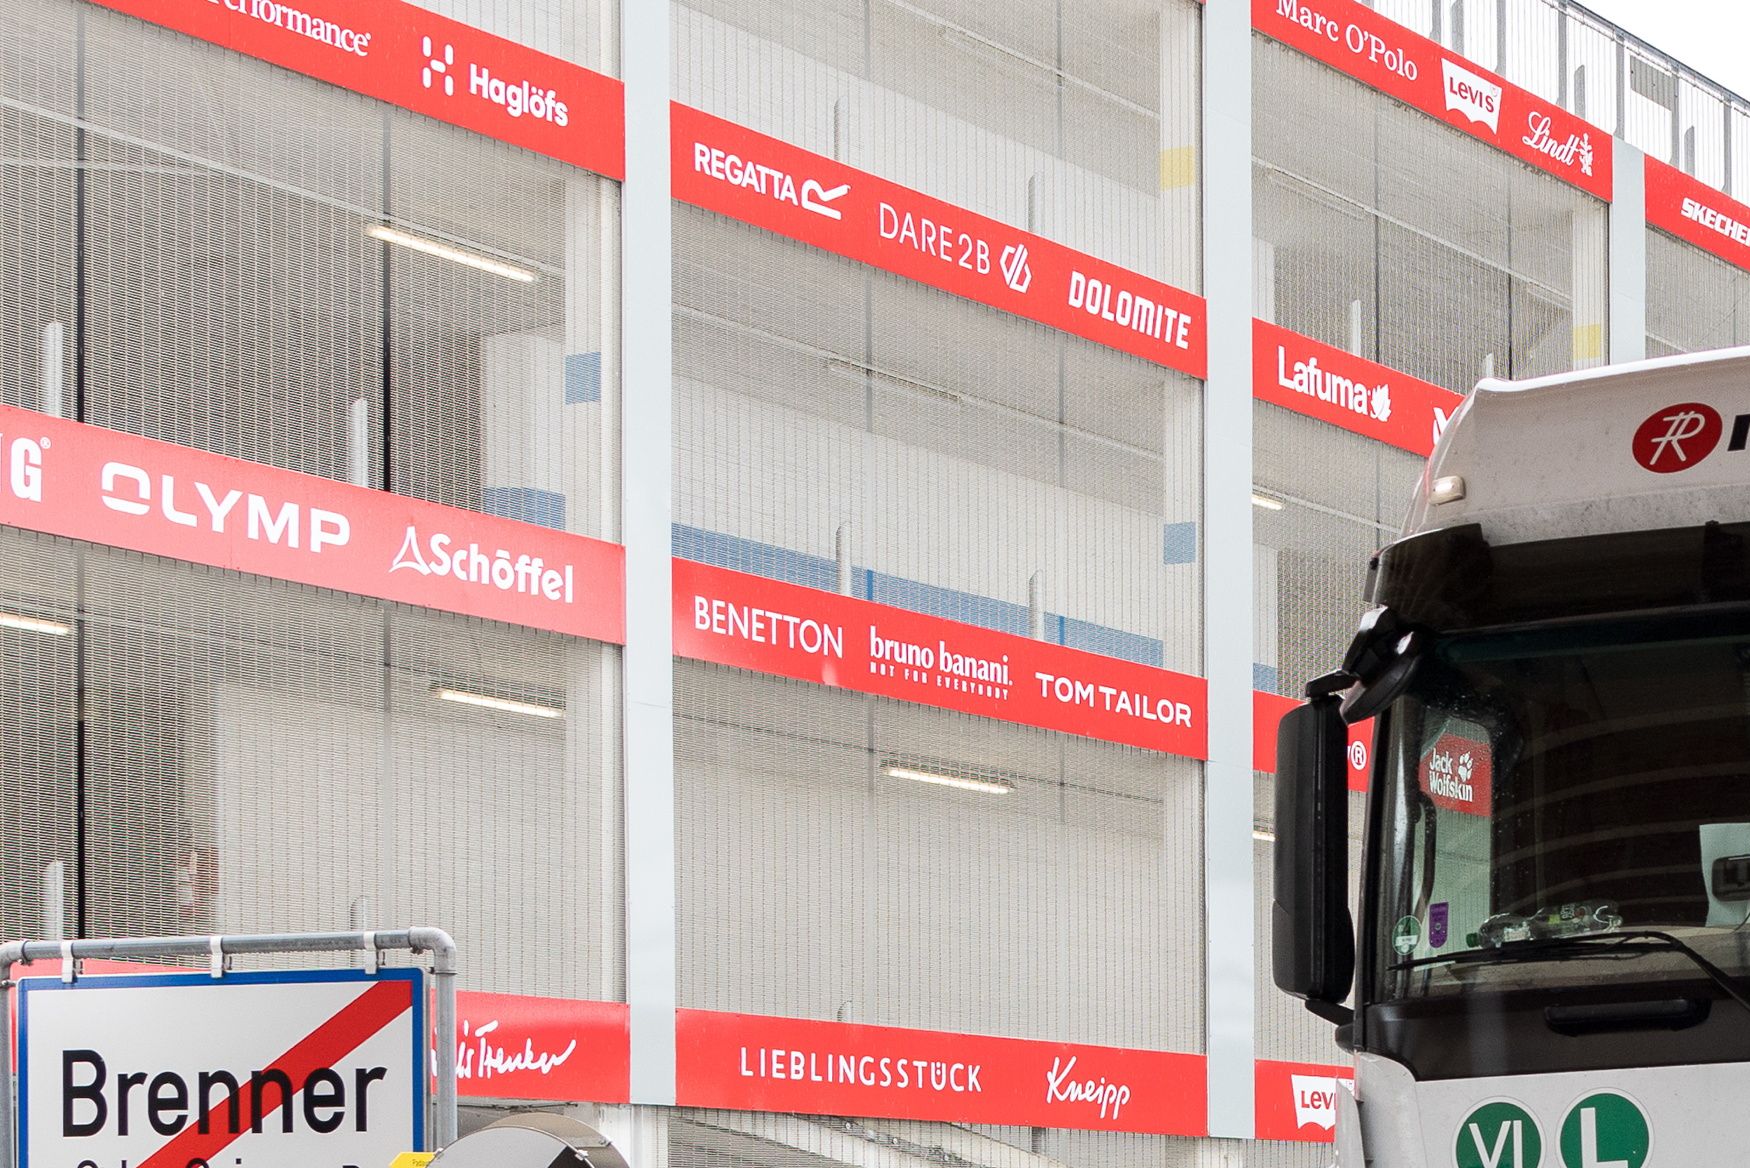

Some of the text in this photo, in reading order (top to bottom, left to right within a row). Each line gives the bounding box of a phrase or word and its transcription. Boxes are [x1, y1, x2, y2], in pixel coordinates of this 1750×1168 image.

[1276, 0, 1419, 81] Marc O'Polo
[469, 62, 569, 127] Haglöfs
[1522, 111, 1578, 166] Lindt
[694, 142, 799, 206] REGATTA
[1068, 270, 1191, 350] DOLOMITE
[1278, 345, 1370, 415] Lafuma
[101, 461, 351, 554] OLYMP
[429, 533, 574, 603] Schöffel
[694, 596, 843, 658] BENETTON
[870, 625, 935, 669] bruno
[1036, 672, 1192, 728] TOM TAILOR
[1429, 748, 1453, 774] Jack
[1429, 770, 1473, 802] Wolfskin
[63, 1049, 388, 1138] Brenner
[739, 1047, 982, 1092] LIEBLINGSSTÜCK
[1045, 1056, 1131, 1120] Kneipp
